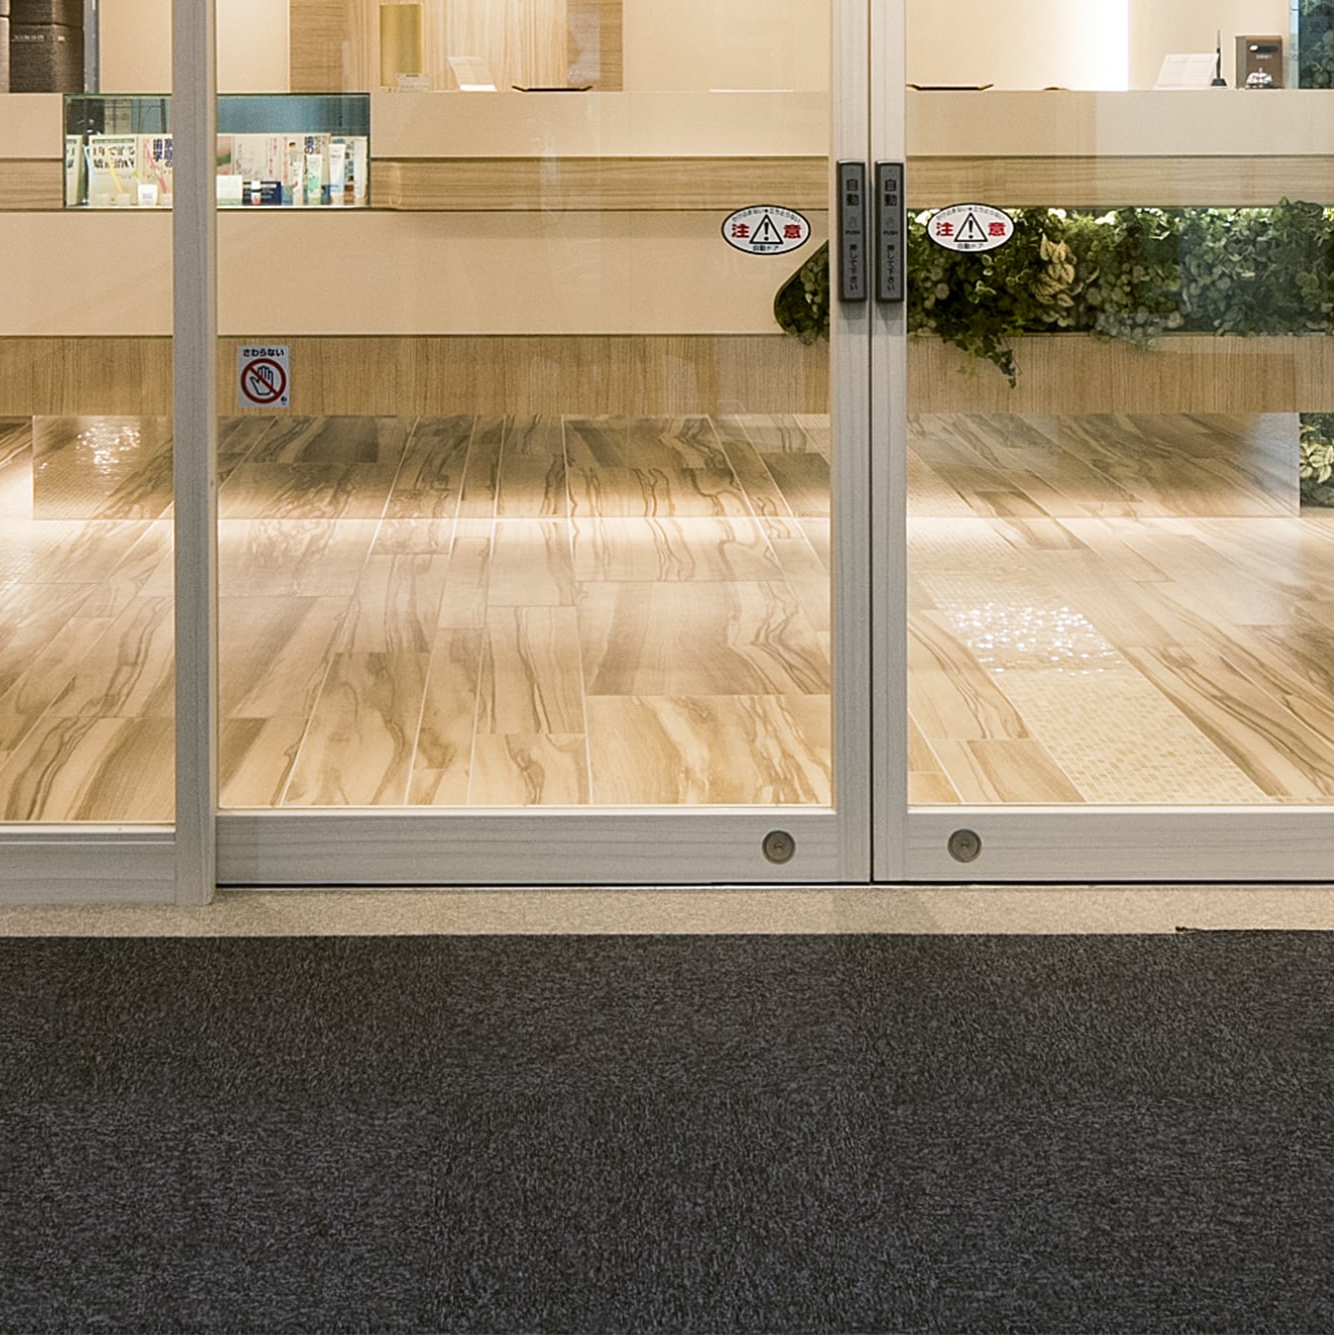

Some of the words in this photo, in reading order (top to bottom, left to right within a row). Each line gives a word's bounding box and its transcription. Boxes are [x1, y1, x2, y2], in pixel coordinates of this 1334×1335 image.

[846, 178, 859, 206] 自動
[884, 178, 897, 206] 自動
[731, 223, 750, 238] 注
[783, 224, 801, 238] 意
[936, 222, 954, 236] 注
[987, 222, 1006, 236] 意
[243, 348, 285, 358] さわらない
